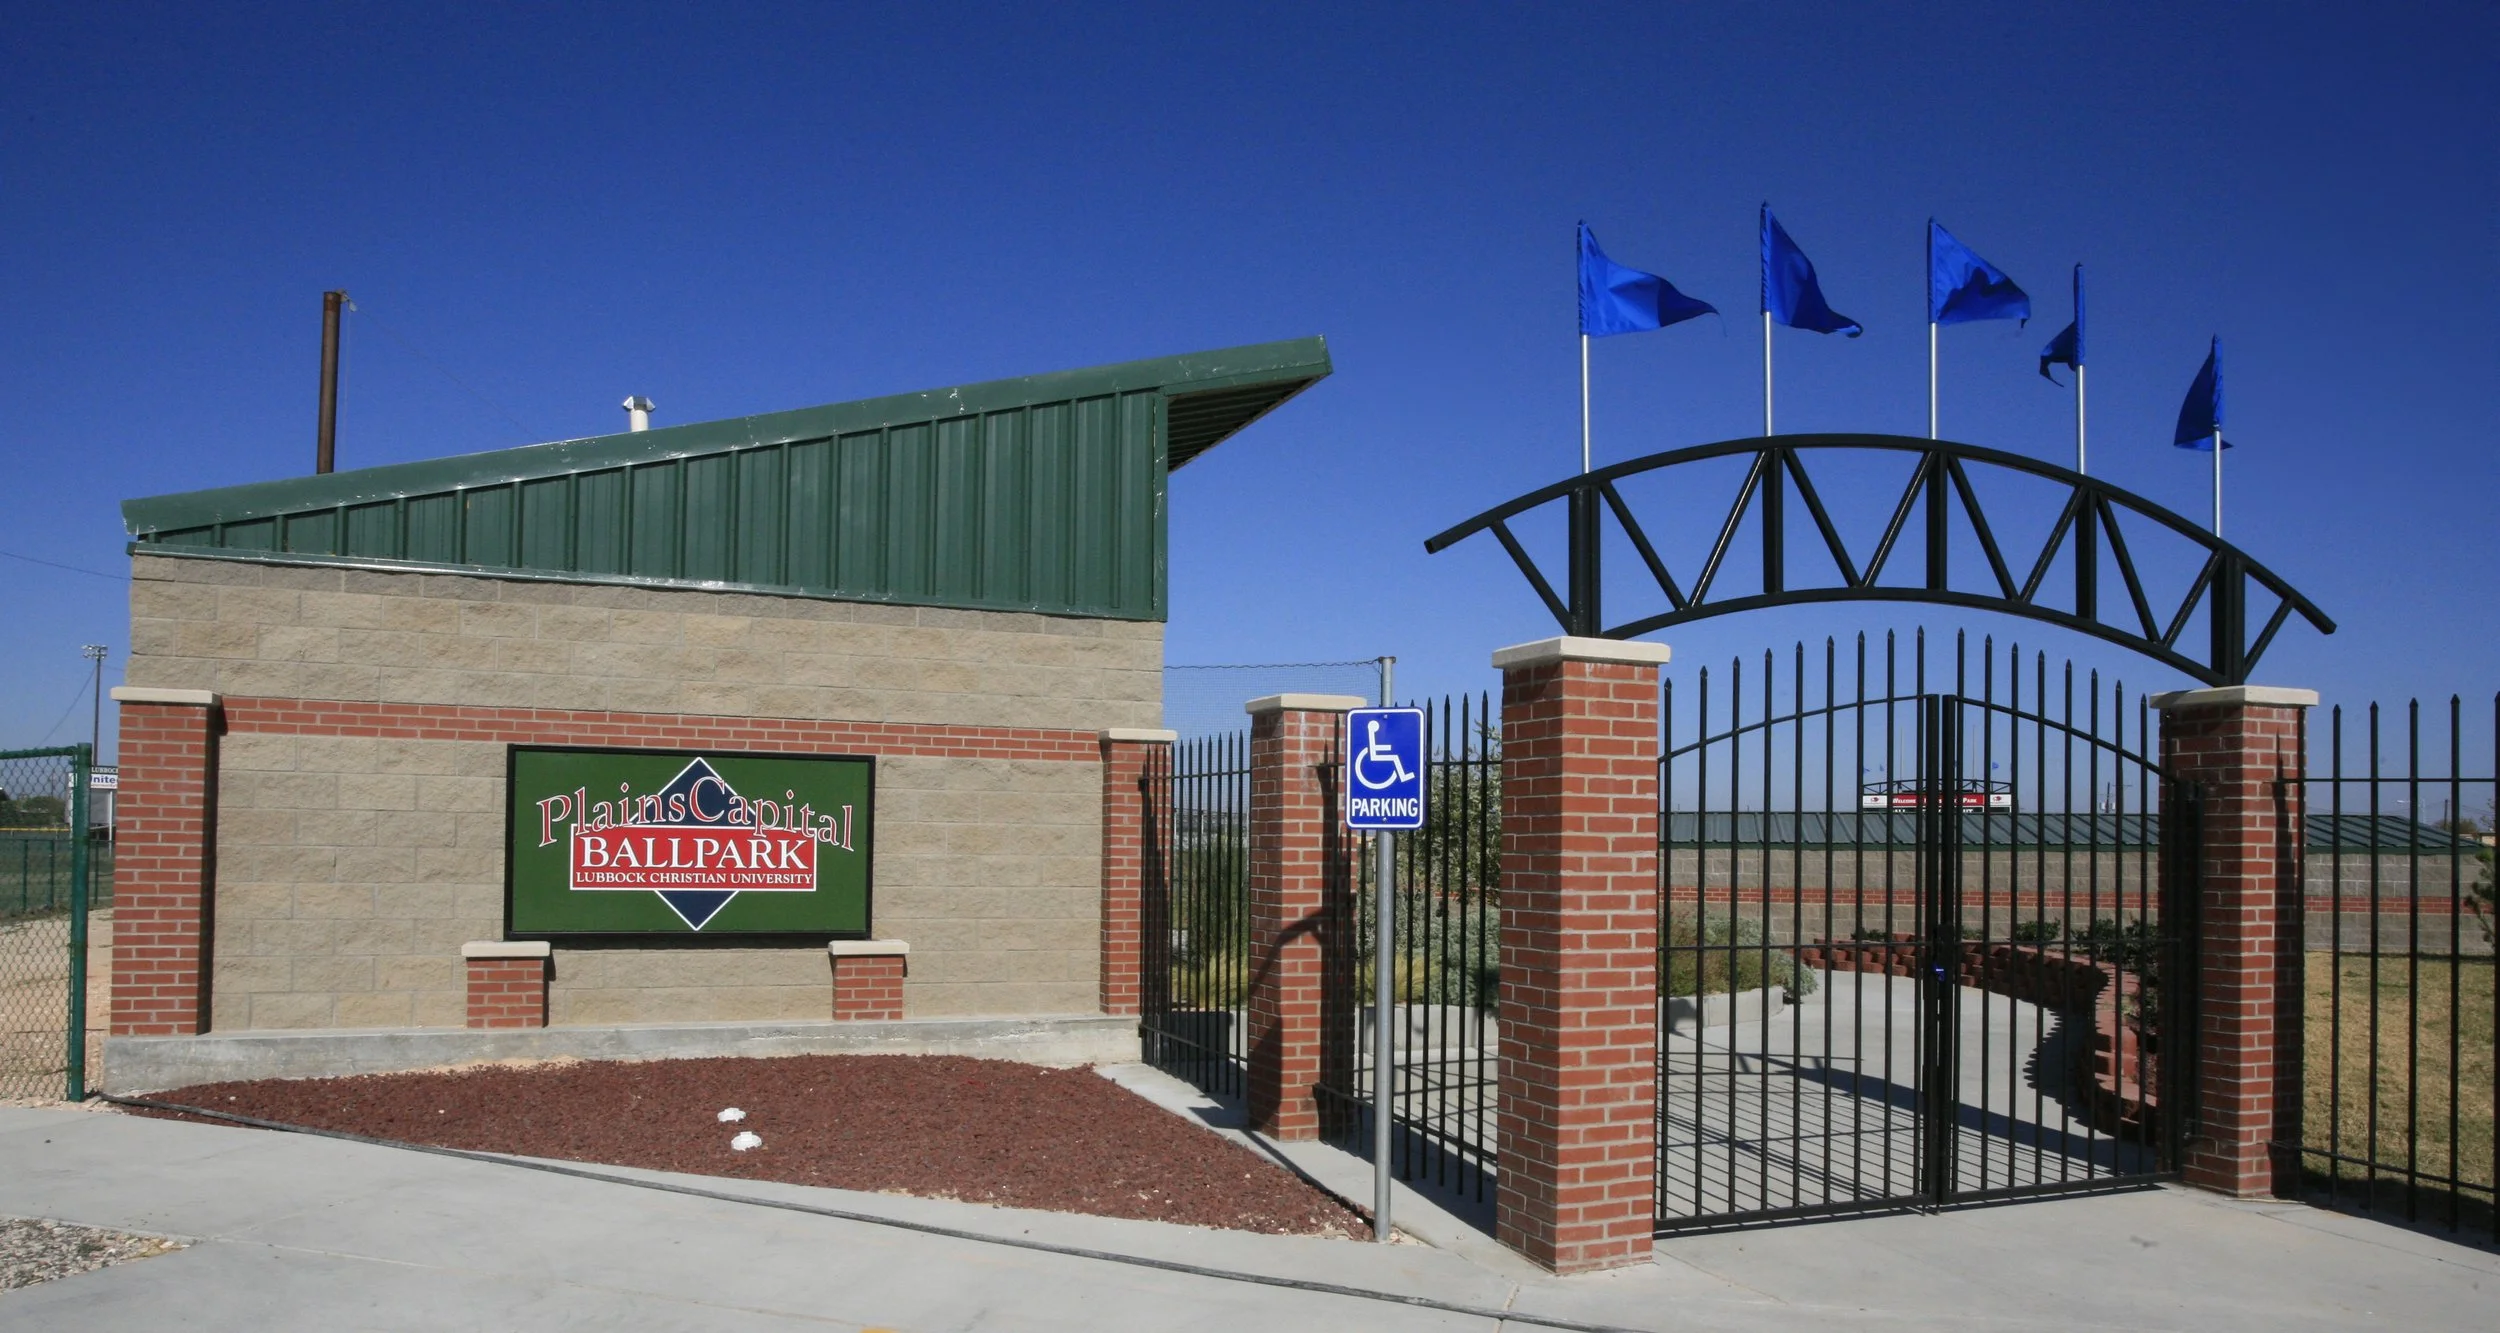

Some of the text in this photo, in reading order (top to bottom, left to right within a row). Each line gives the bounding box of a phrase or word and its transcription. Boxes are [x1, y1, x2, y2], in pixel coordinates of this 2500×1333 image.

[90, 775, 118, 784] nite
[535, 775, 855, 852] PlainsCapital
[1351, 798, 1418, 817] PARKING
[580, 836, 809, 870] BALLPARK
[575, 871, 813, 885] LUBBOCK CHRISTIAN UNIVERSITY
